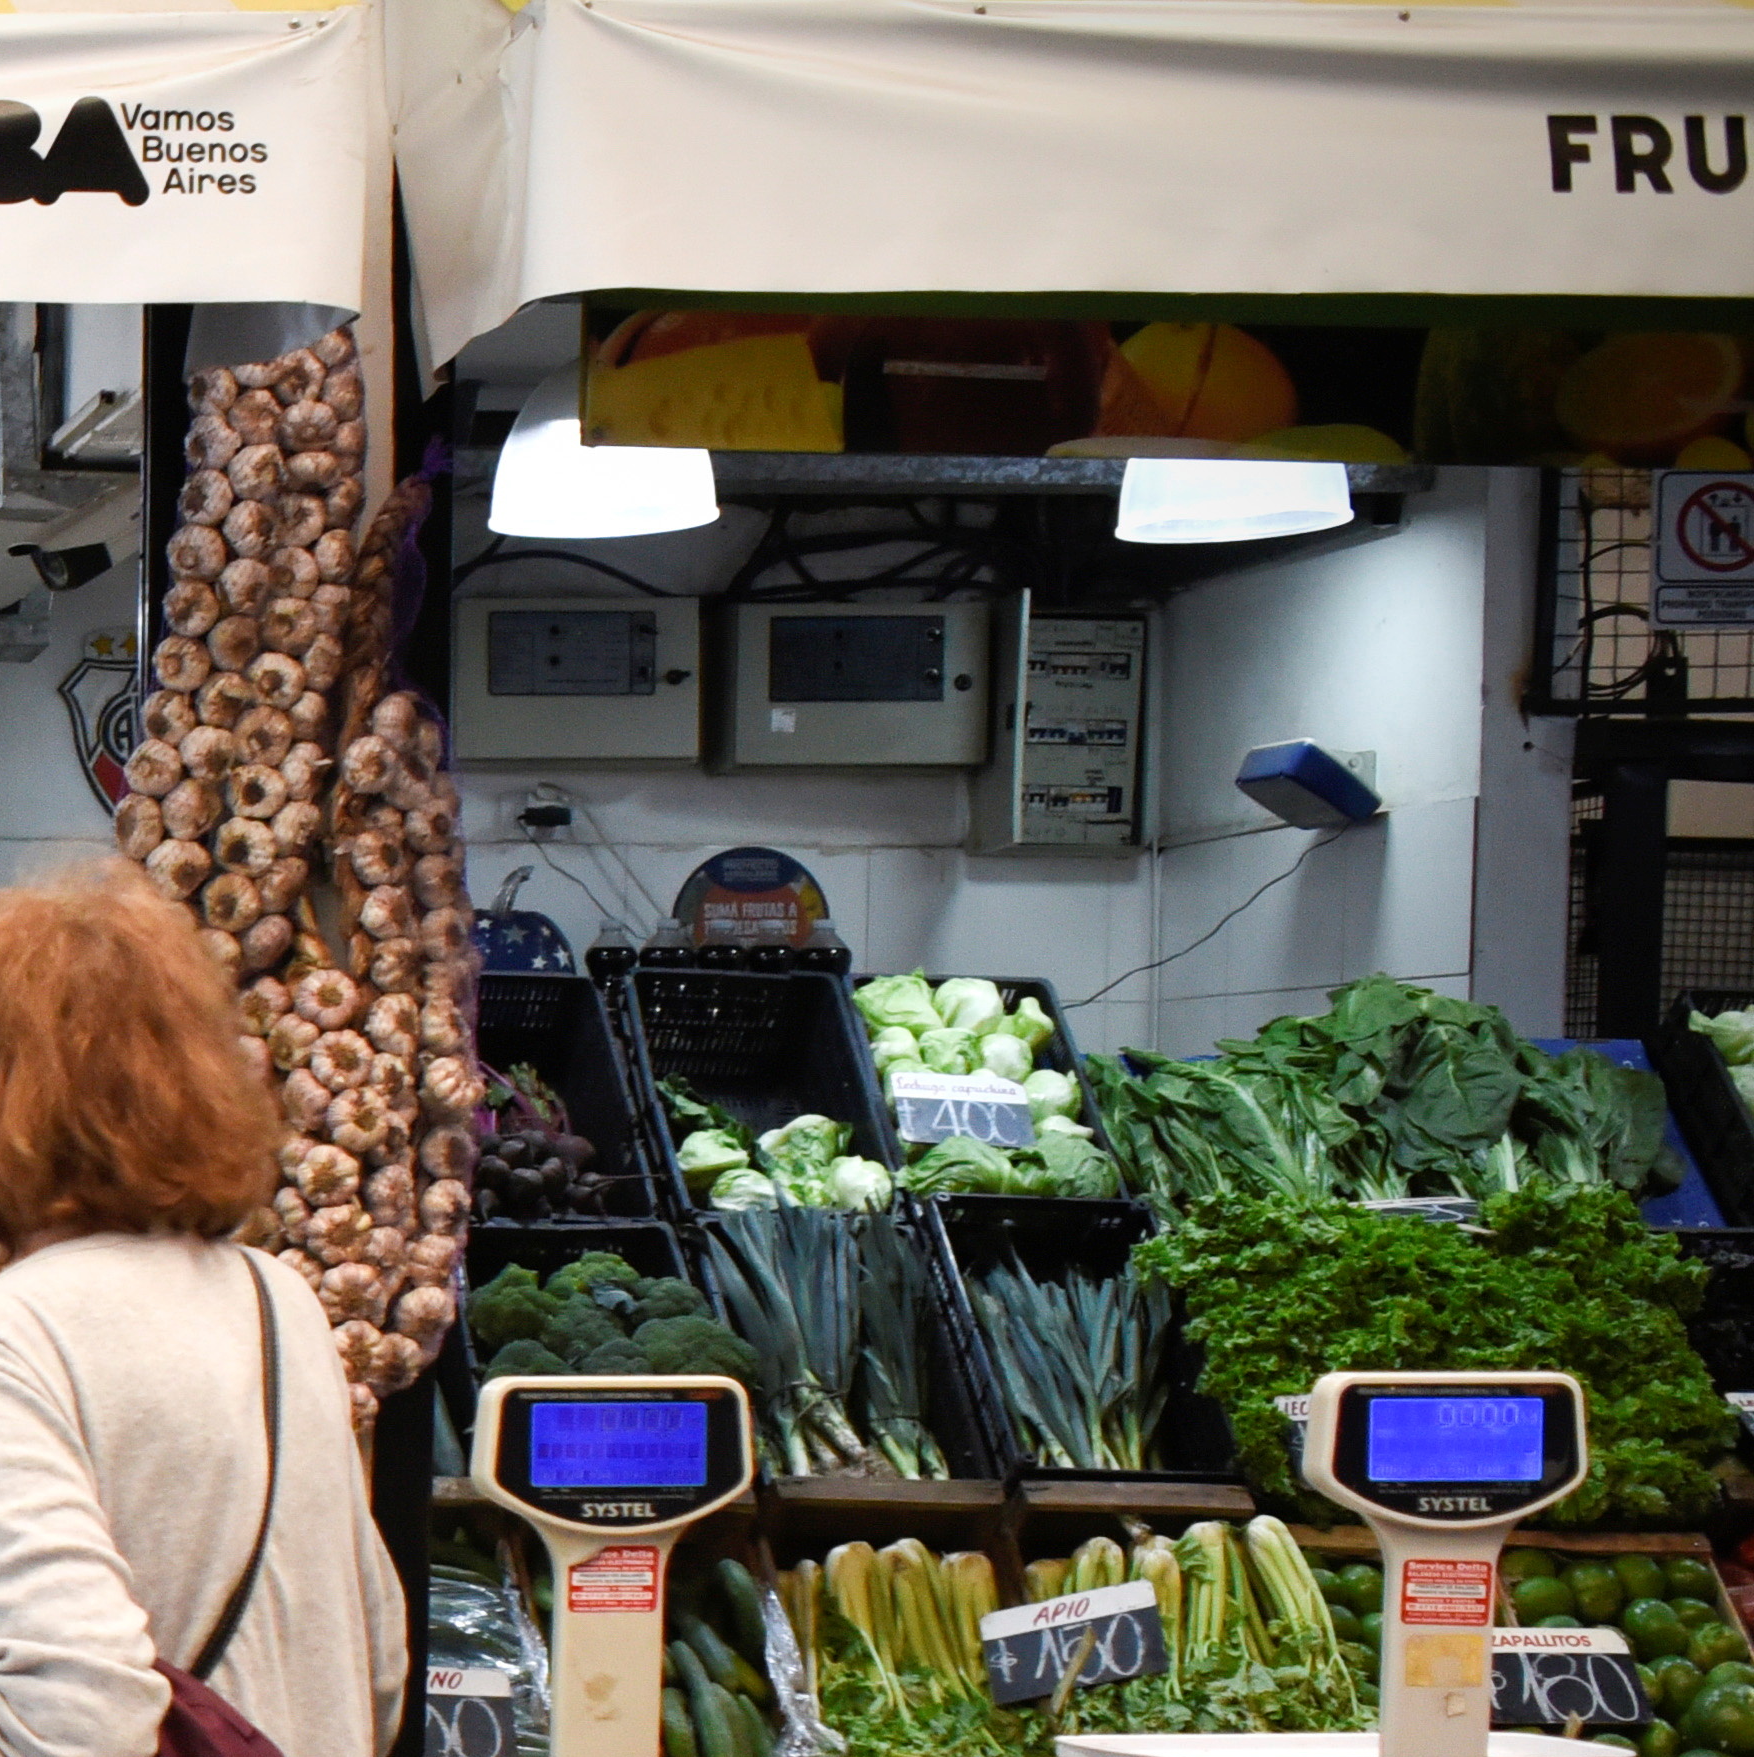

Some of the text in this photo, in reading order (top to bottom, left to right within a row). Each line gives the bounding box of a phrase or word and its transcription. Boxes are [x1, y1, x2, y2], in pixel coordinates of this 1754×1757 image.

[120, 101, 236, 132] Vamos
[140, 134, 269, 165] Buenos
[160, 166, 258, 196] Aires
[580, 1502, 659, 1518] SYSTEL
[1418, 1496, 1493, 1513] SYSTEL
[1032, 1597, 1091, 1626] APIO
[1491, 1634, 1593, 1648] ZAPALLITOS
